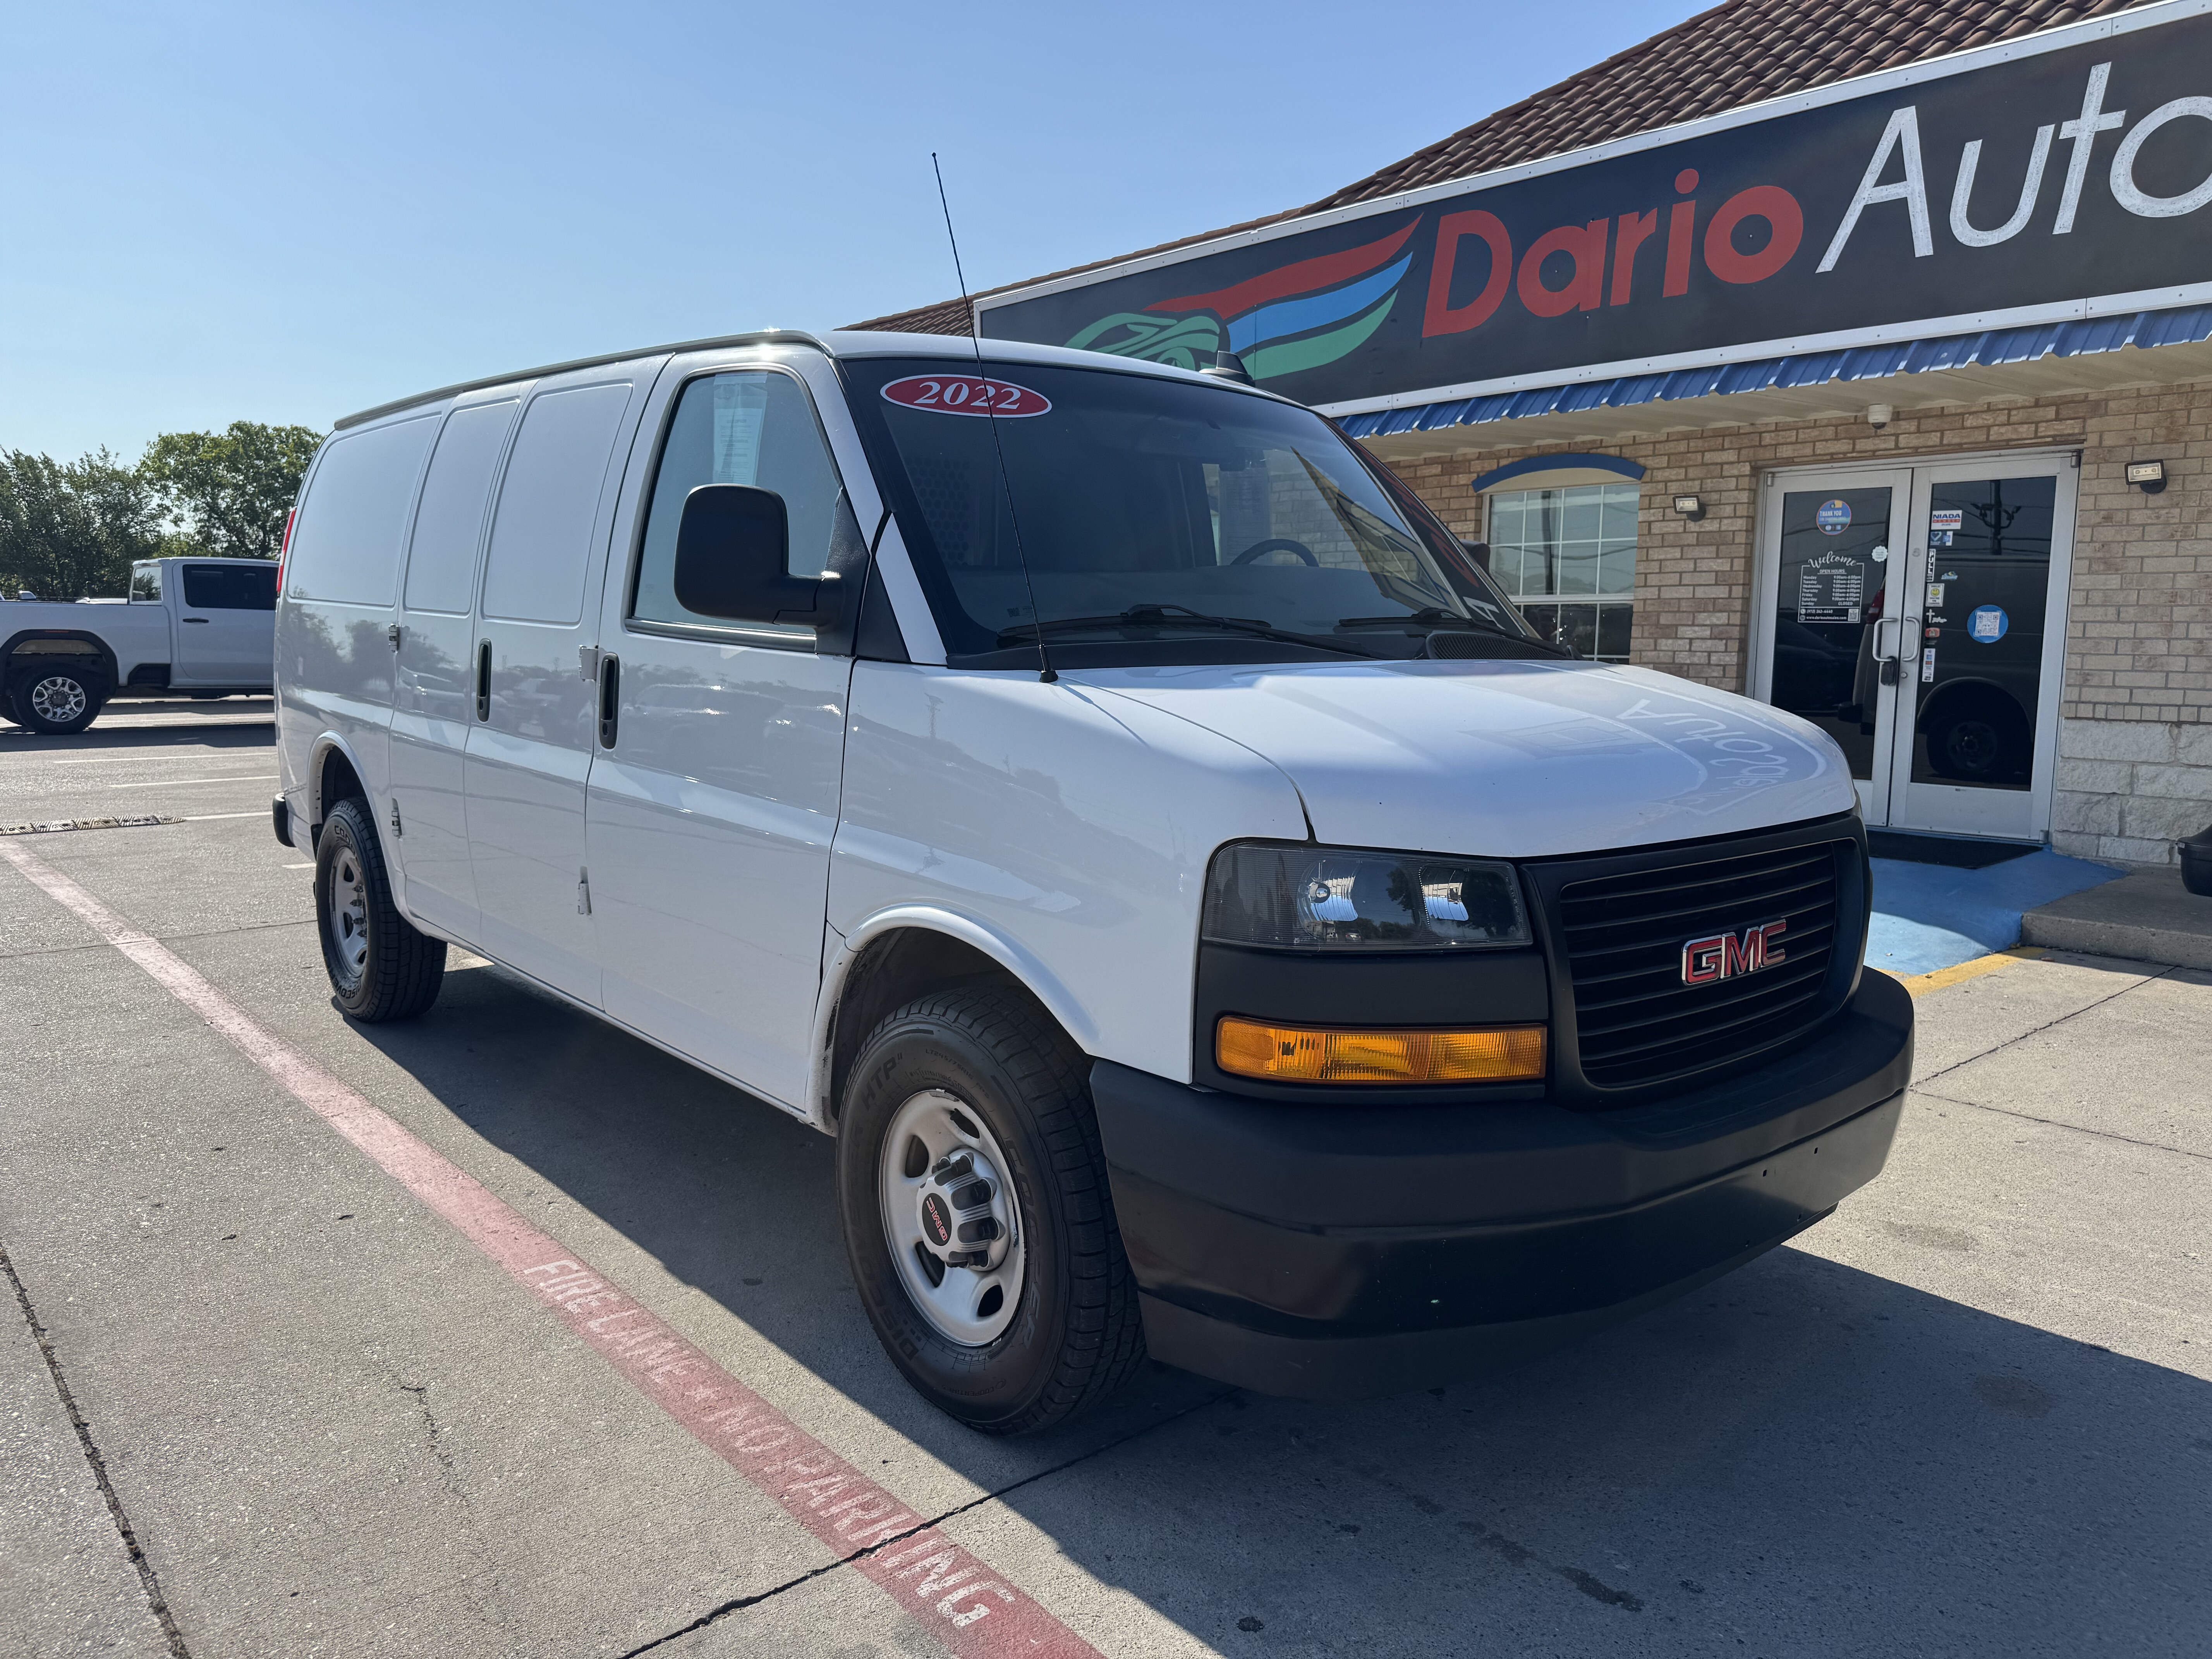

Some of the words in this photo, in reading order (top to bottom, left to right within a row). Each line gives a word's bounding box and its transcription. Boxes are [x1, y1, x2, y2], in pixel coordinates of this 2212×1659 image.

[1422, 168, 1803, 337] Dario
[1815, 61, 2212, 274] Auto
[914, 381, 1021, 409] 2022
[1808, 551, 1856, 568] Welcome
[1681, 918, 1786, 986] GMC
[860, 1056, 897, 1110] HTP
[926, 1197, 948, 1241] GMC
[523, 1260, 621, 1314] FIRE
[587, 1310, 703, 1384] LANE
[701, 1405, 796, 1453] NO
[762, 1446, 1015, 1628] PARKING
